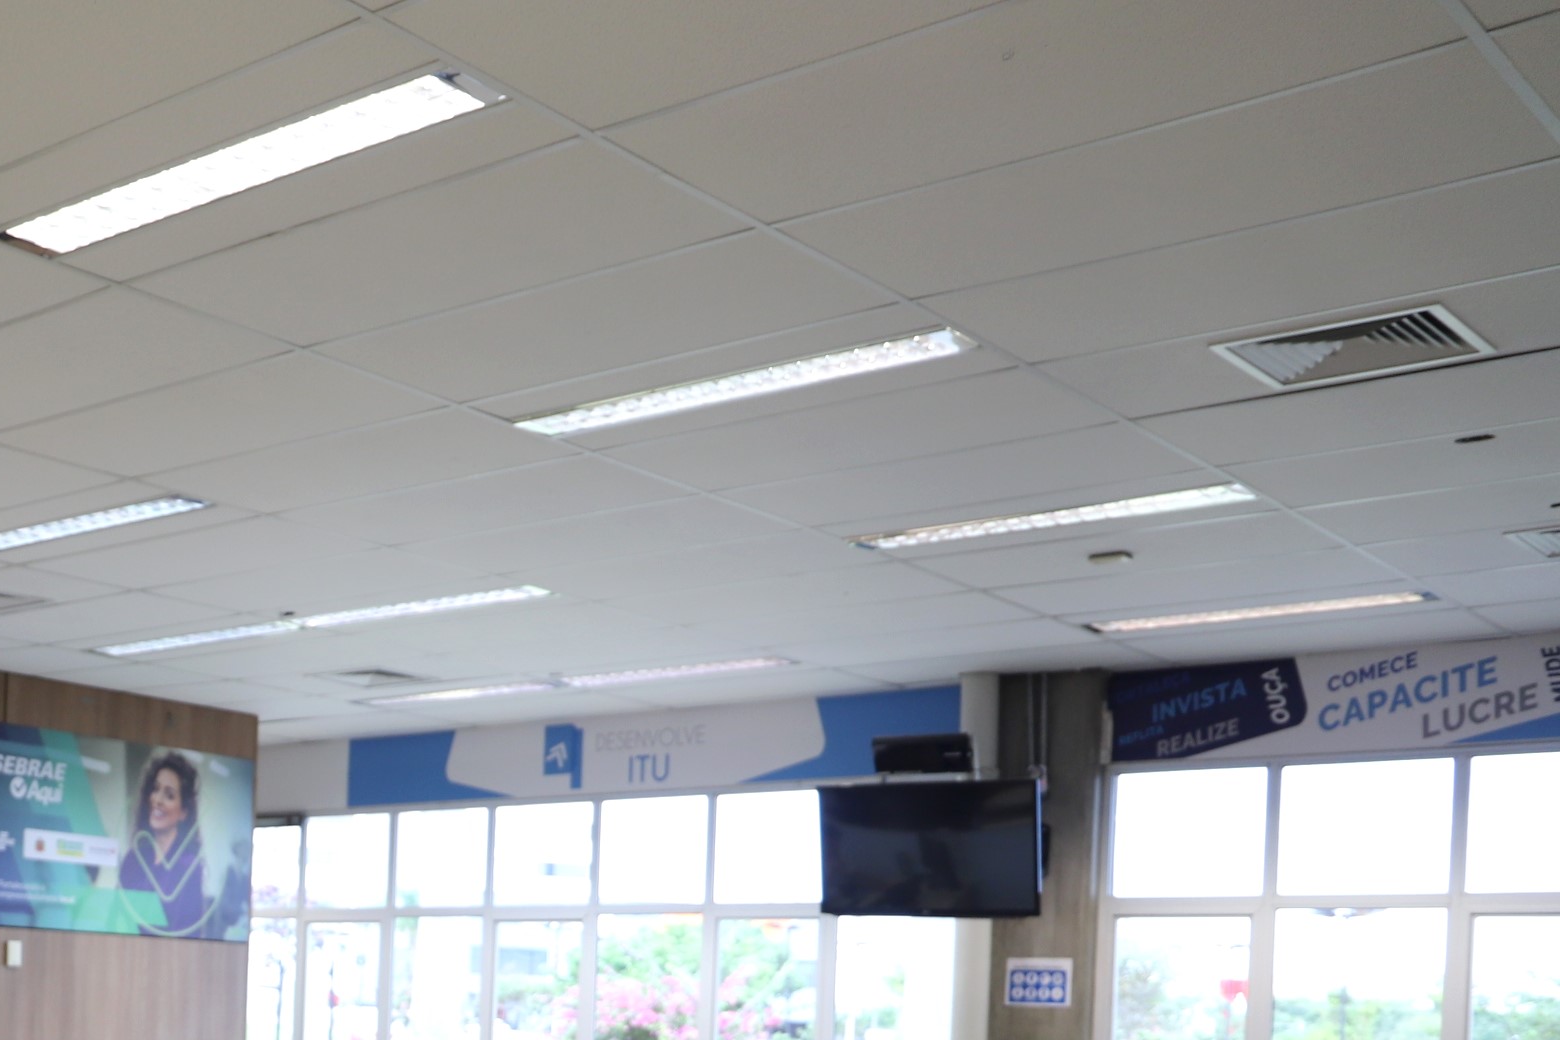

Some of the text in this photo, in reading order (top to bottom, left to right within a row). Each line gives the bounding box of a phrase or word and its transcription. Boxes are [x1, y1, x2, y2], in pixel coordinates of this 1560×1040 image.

[1327, 650, 1419, 692] COMECE
[1151, 678, 1248, 723] INVISTA
[1261, 667, 1290, 725] OUÇA
[1318, 655, 1499, 731] CAPACITE
[1422, 682, 1539, 738] LUCRE
[595, 723, 707, 752] DESENVOLVE
[1156, 717, 1240, 758] REALIZE
[628, 752, 671, 783] ITU
[27, 779, 64, 806] Aqui
